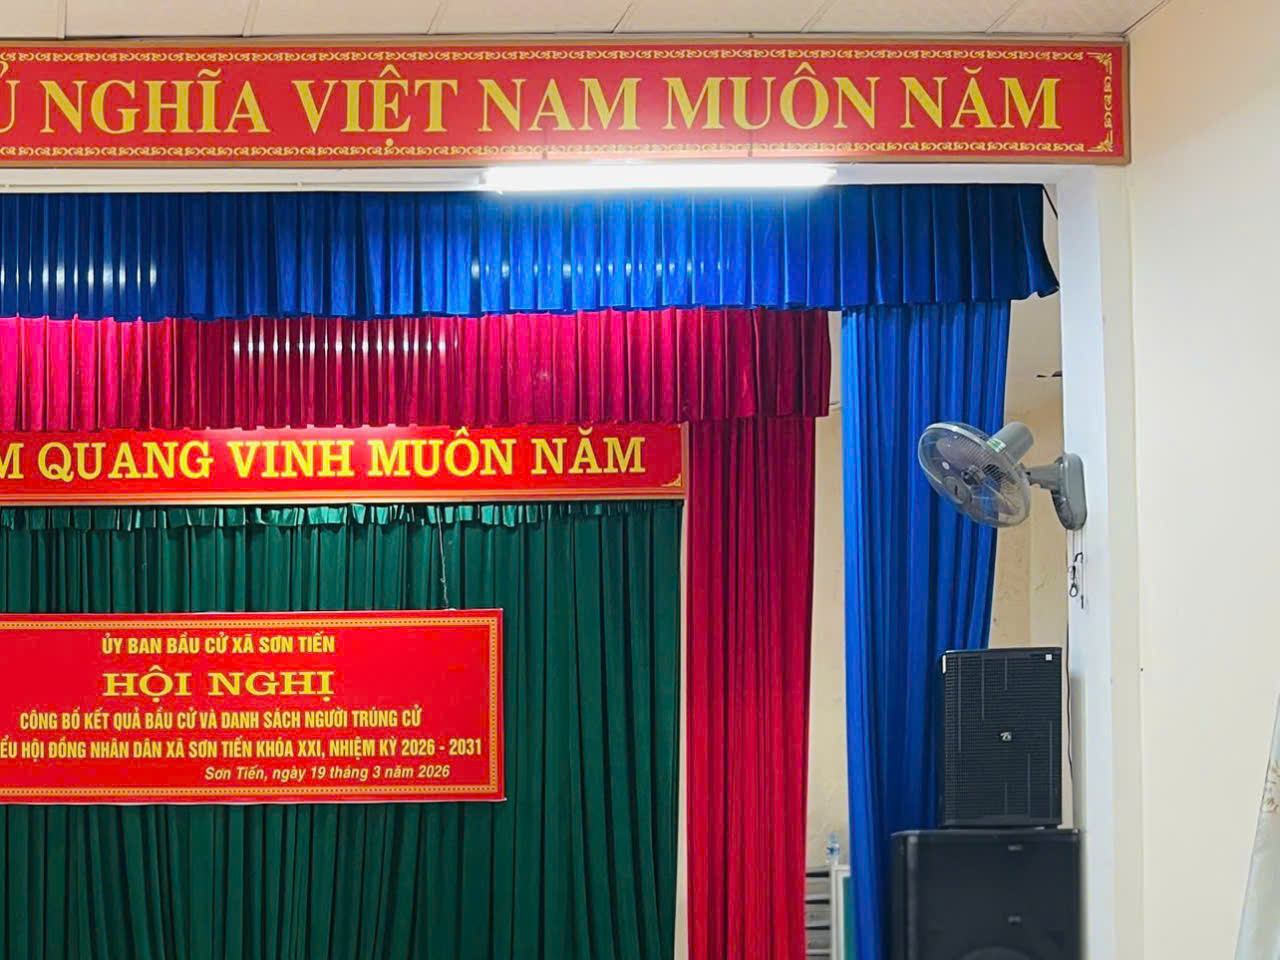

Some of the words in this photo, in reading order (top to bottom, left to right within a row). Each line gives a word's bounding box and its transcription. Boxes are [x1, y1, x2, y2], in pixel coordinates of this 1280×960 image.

[39, 68, 270, 134] NGHĨA
[291, 65, 458, 147] VIỆT
[478, 78, 642, 133] NAM
[661, 62, 877, 130] MUÔN
[900, 66, 1062, 130] NĂM
[38, 440, 213, 482] QUANG
[227, 439, 355, 478] VINH
[367, 427, 517, 477] MUÔN
[531, 427, 645, 474] NĂM
[101, 632, 123, 655] ỦY
[127, 637, 162, 655] BAN
[166, 631, 201, 654] BẦU
[204, 631, 230, 654] CỬ
[231, 633, 255, 654] XÃ
[258, 634, 294, 654] SƠN
[297, 630, 335, 653] TIẾN
[102, 664, 193, 703] HỘI
[207, 671, 335, 703] NGHỊ
[19, 709, 58, 730] CÔNG
[61, 706, 81, 730] BỐ
[84, 707, 110, 730] KẾT
[113, 706, 142, 732] QUẢ
[144, 706, 173, 730] BẦU
[176, 706, 198, 730] CỬ
[199, 708, 218, 729] VÀ
[220, 711, 260, 729] DANH
[263, 707, 301, 729] SÁCH
[304, 706, 348, 729] NGƯỜI
[351, 706, 398, 728] TRÚNG
[401, 703, 423, 727] CỬ
[21, 738, 45, 762] HỘI
[48, 735, 87, 759] ĐỒNG
[90, 737, 130, 759] NHÂN
[133, 737, 163, 759] DÂN
[188, 739, 218, 759] SƠN
[220, 735, 253, 758] TIẾN
[255, 736, 294, 758] KHÓA
[297, 739, 326, 759] XXI,
[329, 735, 376, 761] NHIỆM
[379, 735, 398, 757] KỲ
[401, 738, 436, 756] 2026
[448, 738, 481, 756] 2031
[204, 766, 232, 780] Sơn
[236, 765, 268, 781] Tiến,
[272, 765, 307, 783] ngày
[311, 765, 327, 780] 19
[329, 765, 369, 782] tháng
[372, 765, 381, 779] 3
[384, 765, 414, 778] năm
[417, 764, 450, 778] 2026
